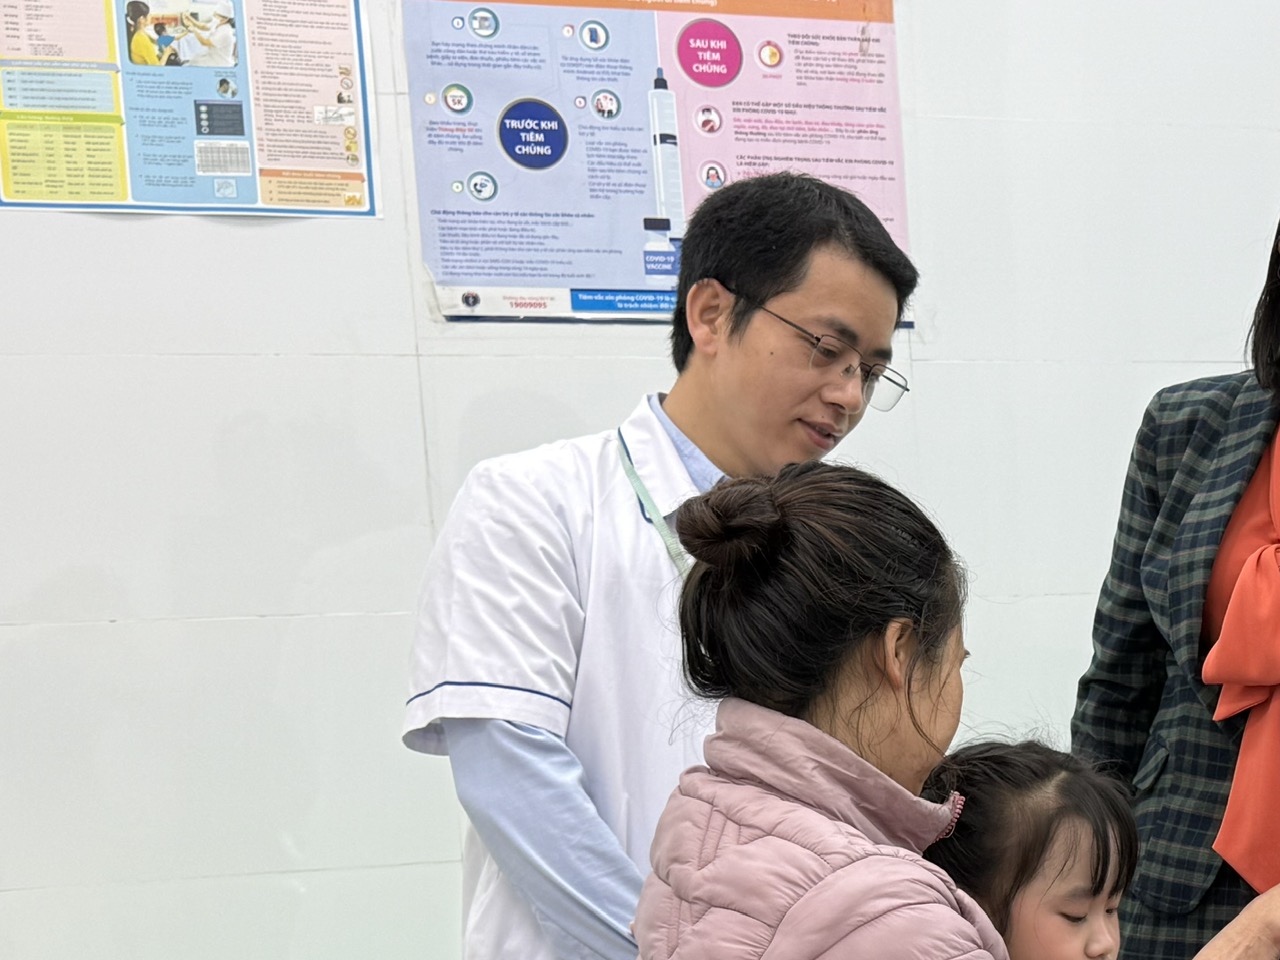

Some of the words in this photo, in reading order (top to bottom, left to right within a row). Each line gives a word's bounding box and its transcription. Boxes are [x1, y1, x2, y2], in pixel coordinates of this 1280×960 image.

[689, 38, 708, 48] SAU
[710, 40, 727, 49] KHI
[697, 51, 721, 61] TIÊM
[692, 62, 727, 74] CHỦNG
[504, 118, 539, 130] TRƯỚC
[541, 120, 558, 130] KHI
[520, 131, 544, 142] TIÊM
[515, 143, 551, 155] CHỦNG
